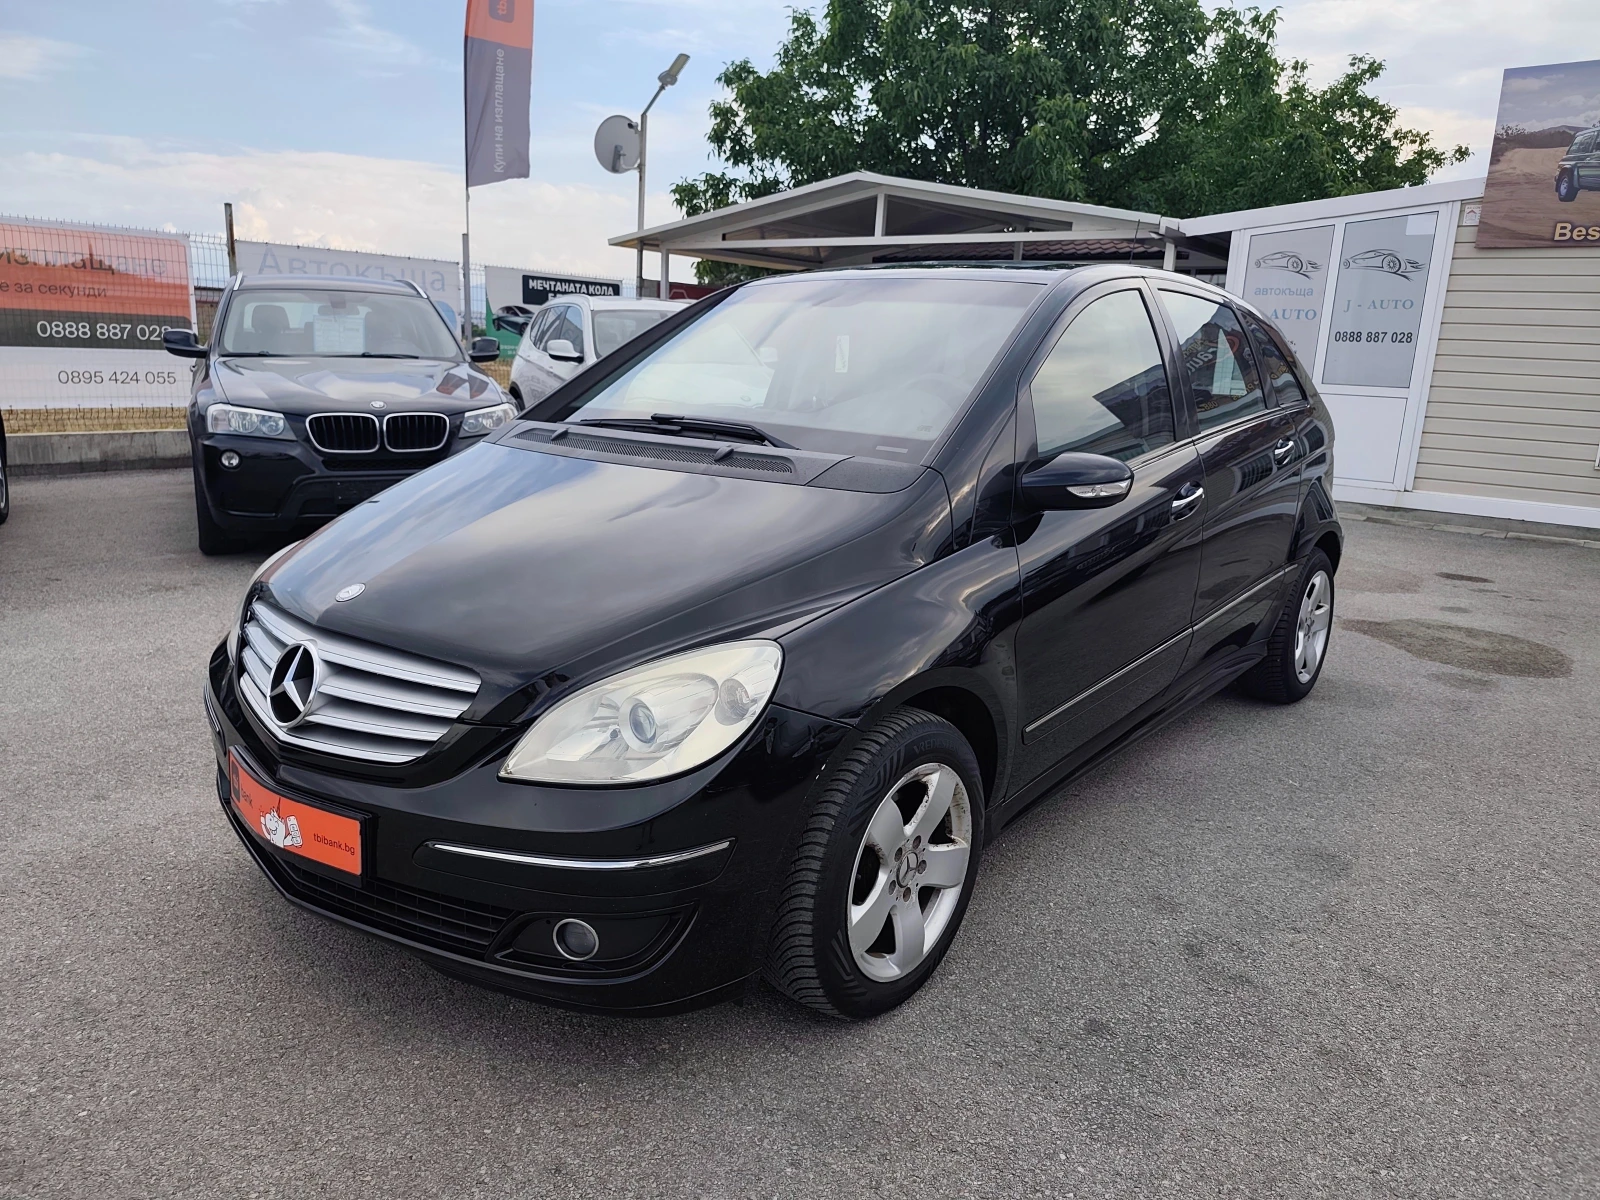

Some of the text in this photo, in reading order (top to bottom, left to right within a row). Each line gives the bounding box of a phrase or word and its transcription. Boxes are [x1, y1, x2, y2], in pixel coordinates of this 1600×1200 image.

[494, 48, 506, 173] Купи на изплащане
[14, 281, 33, 292] за
[38, 283, 107, 298] секунди
[528, 278, 614, 296] МЕЧТАНАТА КОЛА
[1254, 287, 1314, 298] автокъща
[1367, 298, 1414, 310] AUTO
[1270, 308, 1317, 320] AUTO
[36, 320, 91, 338] 0888
[96, 322, 132, 340] 887
[1334, 330, 1413, 344] 0888 887 028
[57, 370, 177, 385] 0895 424 055
[313, 833, 355, 856] tbibank.bg
